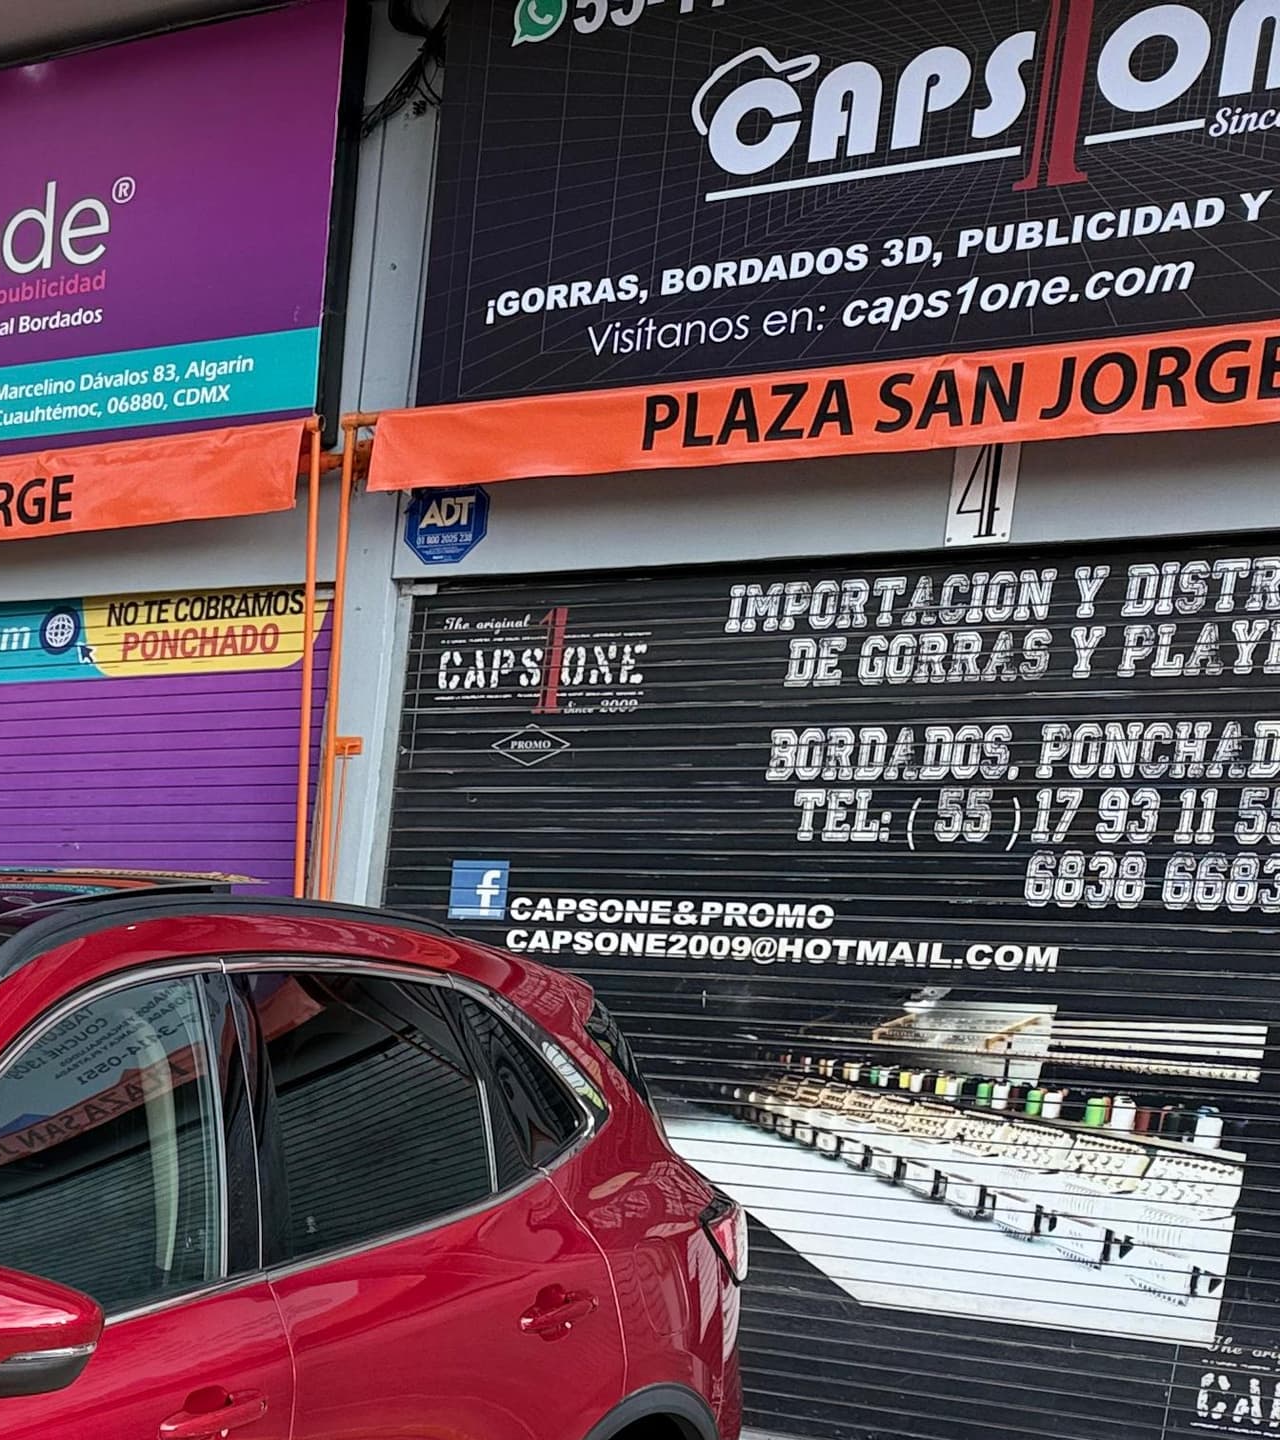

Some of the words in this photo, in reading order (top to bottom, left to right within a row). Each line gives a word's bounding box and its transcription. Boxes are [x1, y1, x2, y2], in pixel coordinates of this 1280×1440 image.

[1209, 107, 1280, 137] Sinc
[485, 272, 649, 325] ¡GORRAS,
[660, 244, 869, 297] BORDADOS
[879, 235, 944, 272] 3D,
[957, 196, 1226, 259] PUBLICIDAD
[1240, 189, 1274, 223] Y
[18, 306, 104, 335] Bordados
[587, 311, 750, 360] Visítanos
[762, 302, 827, 338] en:
[841, 258, 1196, 331] caps1one.com
[79, 366, 149, 393] Dávalos
[152, 363, 181, 383] 83,
[107, 391, 168, 414] 06880,
[172, 383, 232, 406] CDMX
[641, 379, 853, 452] PLAZA
[874, 362, 1029, 433] SAN
[956, 443, 1003, 538] 4
[418, 495, 477, 529] ADT
[106, 602, 139, 628] NO
[143, 598, 170, 624] TE
[174, 589, 307, 623] COBRAMOS
[724, 567, 1058, 633] IMPORTACION
[1074, 565, 1111, 619] Y
[1120, 556, 1280, 618] DISTR
[122, 622, 280, 662] PONCHADO
[443, 616, 470, 631] The
[476, 613, 531, 635] original
[438, 647, 544, 690] CAPS
[560, 642, 648, 686] ONE
[783, 636, 847, 688] DE
[857, 628, 1055, 687] GORRAS
[1070, 625, 1107, 679] Y
[598, 698, 639, 713] 2009
[510, 739, 552, 751] PROMO
[765, 724, 1019, 782] BORDADOS,
[793, 788, 891, 843] TEL:
[1030, 787, 1084, 844] 17
[1095, 787, 1161, 844] 93
[1173, 788, 1219, 844] 11
[1024, 849, 1148, 908] 6838
[1161, 850, 1280, 913] 6683
[509, 896, 836, 931] CAPSONE&PROMO
[505, 929, 1060, 973] CAPSONE2009@HOTMAIL.COM
